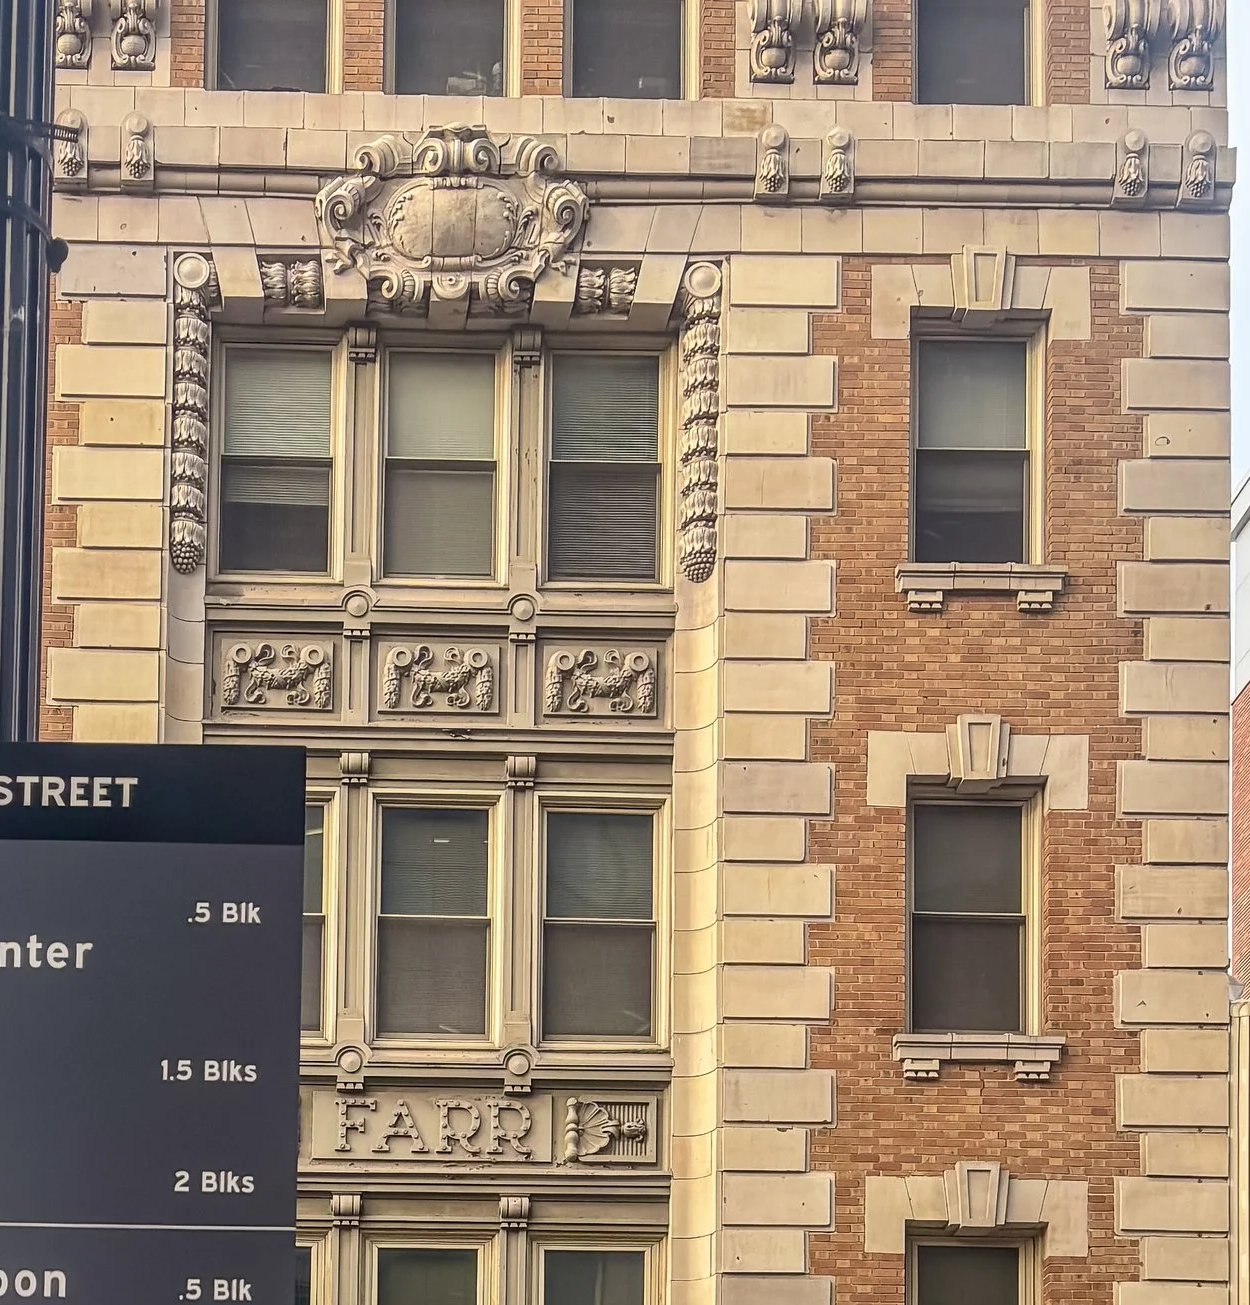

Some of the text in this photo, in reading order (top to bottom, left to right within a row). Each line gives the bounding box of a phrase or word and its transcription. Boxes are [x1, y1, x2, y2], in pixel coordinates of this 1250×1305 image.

[187, 902, 261, 924] .5 Blk
[161, 1060, 257, 1082] 1.5 Blks
[334, 1097, 533, 1155] FARR
[175, 1171, 255, 1194] 2 Blks
[178, 1279, 252, 1301] .5 Blk
